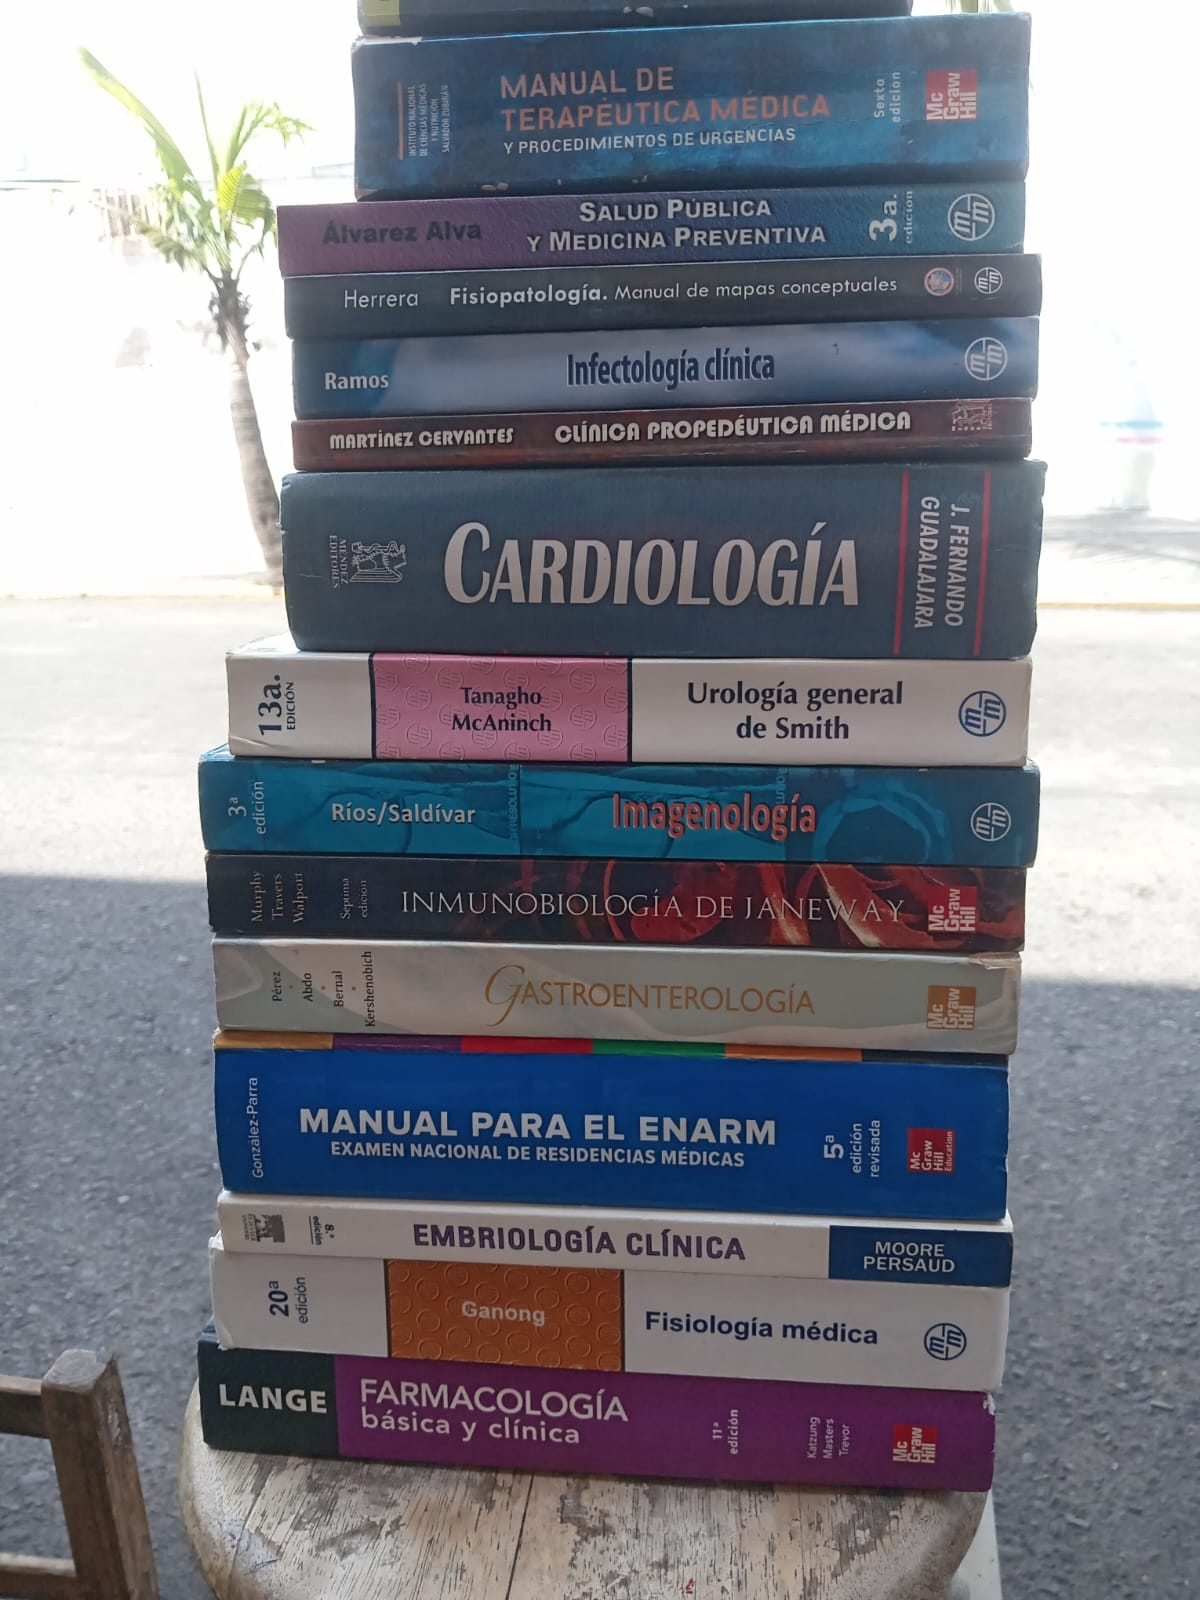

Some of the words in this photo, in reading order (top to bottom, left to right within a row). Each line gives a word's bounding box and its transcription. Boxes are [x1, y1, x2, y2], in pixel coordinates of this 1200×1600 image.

[500, 70, 626, 98] MANUAL
[637, 67, 675, 91] DE
[943, 73, 960, 120] Graw
[408, 85, 417, 121] NACIONAL
[501, 96, 702, 131] TERAPÉUTICA
[711, 90, 831, 120] MÉDICA
[927, 92, 943, 121] Mc
[959, 91, 977, 119] Hill
[408, 122, 417, 156] INSTITUTO
[419, 116, 428, 147] CIENCIAS
[441, 118, 450, 153] SALVADOR
[504, 142, 513, 154] Y
[518, 134, 667, 153] PROCEDIMIENTOS
[673, 133, 694, 146] DE
[700, 127, 796, 146] URGENCIAS
[419, 148, 428, 156] DE
[579, 202, 660, 222] SALUD
[666, 197, 772, 219] PÚBLICA
[868, 193, 898, 242] 3a.
[322, 222, 418, 244] Álvarez
[426, 221, 481, 241] Alva
[550, 230, 666, 251] MEDICINA
[674, 226, 827, 248] PREVENTIVA
[344, 290, 419, 308] Herrera
[450, 285, 608, 307] Fisiopatología.
[614, 284, 680, 299] Manual
[686, 282, 710, 298] de
[716, 283, 776, 299] mapas
[781, 277, 898, 296] conceptuales
[324, 371, 390, 390] Ramos
[566, 350, 700, 391] Infectología
[705, 347, 775, 381] clínica
[329, 429, 414, 450] MARTÍNEZ
[418, 427, 514, 447] CERVANTES
[555, 421, 640, 443] CLÍNICA
[647, 413, 814, 440] PROPEDÉUTICA
[820, 409, 912, 434] MÉDICA
[950, 503, 970, 517] J.
[329, 535, 340, 589] EDITORES
[444, 521, 859, 607] CARDIOLOGÍA
[914, 496, 940, 629] GUADALAJARA
[944, 524, 970, 627] FERNANDO
[258, 673, 282, 737] 13a.
[284, 681, 297, 731] EDICIÓN
[460, 686, 542, 710] Tanagho
[687, 681, 798, 711] Urología
[807, 681, 903, 712] general
[451, 712, 552, 733] McAninch
[735, 715, 767, 740] de
[775, 716, 850, 740] Smith
[251, 780, 266, 835] edición
[331, 800, 476, 824] Ríos/Saldívar
[611, 792, 817, 841] Imagenología
[249, 870, 266, 923] Murphy
[271, 873, 284, 921] Travers
[292, 872, 308, 923] Walport
[401, 889, 683, 918] INMUNOBIOLOGÍA
[696, 895, 733, 920] DE
[745, 896, 904, 923] JANEWAY
[943, 888, 961, 933] Graw
[928, 904, 944, 932] Mc
[960, 905, 977, 933] Hill
[271, 970, 282, 1003] Pérez
[302, 972, 313, 1003] Abdo
[333, 970, 344, 1007] Bernal
[364, 950, 377, 1028] Kershenobich
[485, 964, 816, 1027] GASTROENTEROLOGÍA
[927, 1004, 943, 1029] Mc
[942, 987, 960, 1030] Graw
[958, 1005, 975, 1030] Hill
[246, 1077, 263, 1179] González-Parra
[300, 1107, 458, 1138] MANUAL
[471, 1111, 571, 1140] PARA
[584, 1114, 624, 1142] EL
[639, 1116, 777, 1146] ENARM
[330, 1141, 405, 1158] EXAMEN
[410, 1143, 502, 1161] NACIONAL
[507, 1146, 531, 1161] DE
[536, 1147, 656, 1166] RESIDENCIAS
[661, 1147, 745, 1168] MÉDICAS
[850, 1122, 862, 1173] edición
[870, 1119, 881, 1178] revisada
[910, 1151, 921, 1170] Mc
[922, 1139, 933, 1171] Graw
[933, 1151, 944, 1171] Hill
[945, 1131, 953, 1172] Education
[312, 1215, 323, 1246] edición
[413, 1223, 616, 1255] EMBRIOLOGÍA
[626, 1229, 746, 1261] CLÍNICA
[863, 1255, 956, 1273] PERSAUD
[875, 1240, 945, 1257] MOORE
[294, 1276, 307, 1324] edición
[461, 1300, 546, 1327] Ganong
[645, 1311, 774, 1341] Fisiología
[782, 1320, 879, 1346] médica
[218, 1383, 328, 1414] LANGE
[360, 1378, 629, 1423] FARMACOLOGÍA
[361, 1407, 451, 1435] básica
[461, 1418, 477, 1442] y
[488, 1413, 580, 1444] clínica
[728, 1408, 739, 1455] edición
[807, 1416, 821, 1459] Katzung
[823, 1418, 834, 1459] Masters
[838, 1423, 850, 1457] Trevor
[893, 1441, 907, 1462] Mc
[907, 1427, 922, 1463] Graw
[921, 1442, 936, 1463] Hill
